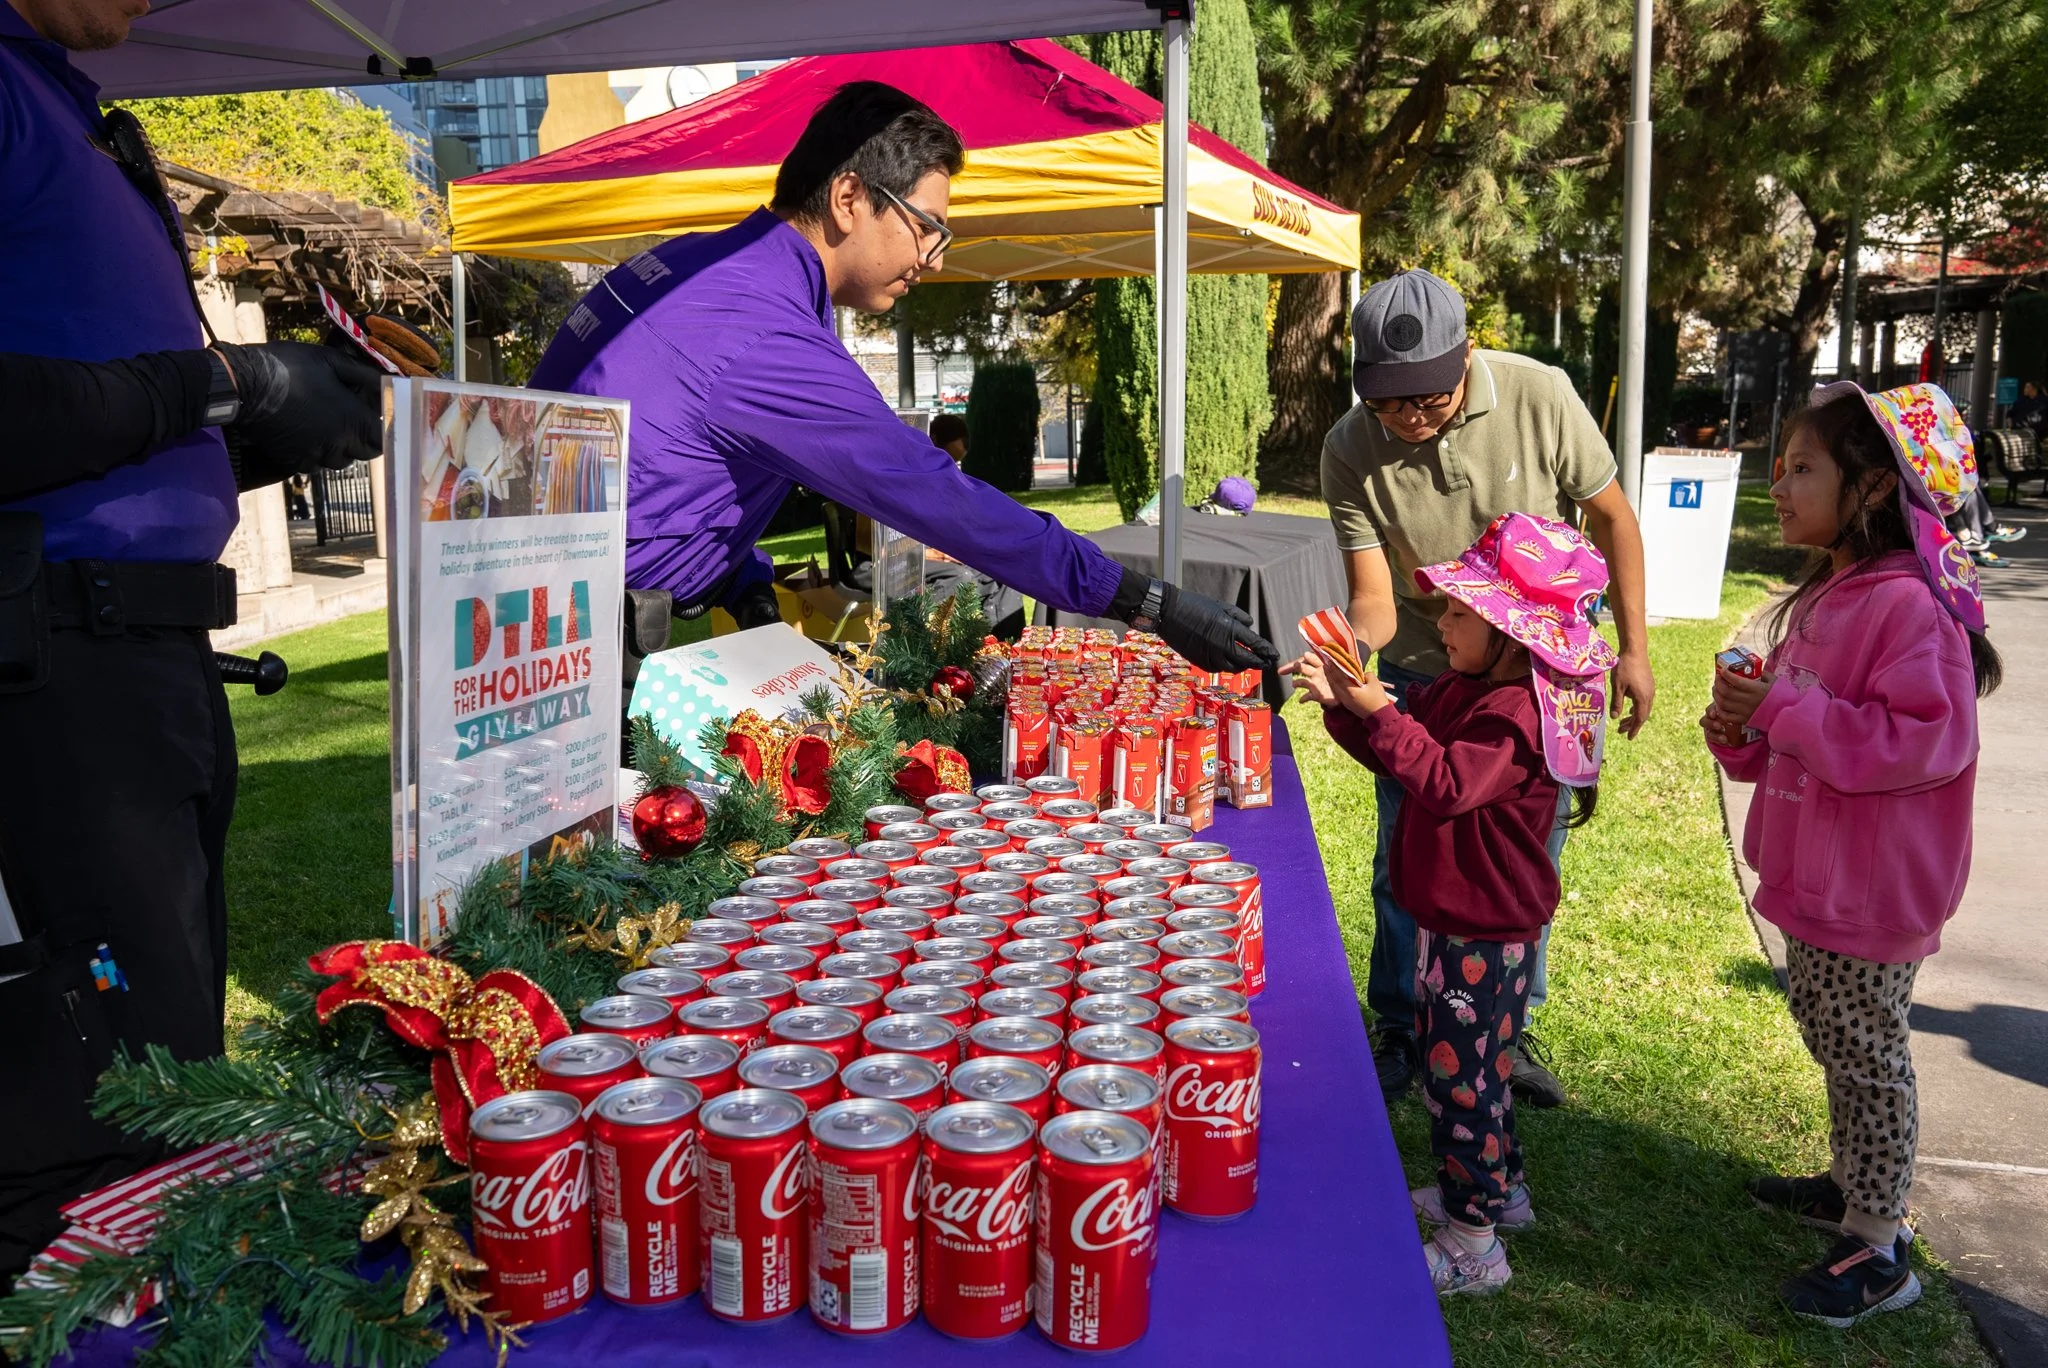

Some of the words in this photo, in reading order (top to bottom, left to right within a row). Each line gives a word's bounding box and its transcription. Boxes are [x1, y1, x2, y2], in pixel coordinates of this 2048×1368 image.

[1252, 181, 1278, 223] SUN
[1276, 195, 1312, 237] DEVILS
[626, 251, 673, 286] STRICT
[441, 542, 466, 556] Three
[467, 540, 488, 555] lucky
[488, 538, 519, 552] winners
[520, 536, 533, 547] will
[533, 535, 543, 546] be
[543, 533, 570, 545] treated
[570, 533, 578, 543] to
[584, 530, 610, 544] magical
[439, 562, 472, 577] holiday
[472, 556, 512, 573] adventure
[512, 554, 521, 567] in
[521, 554, 534, 566] the
[534, 551, 553, 565] heart
[553, 550, 563, 566] of
[563, 547, 599, 561] Downtown
[599, 545, 610, 558] LA!
[455, 580, 592, 671] DTLA
[454, 676, 477, 698] FOR
[479, 646, 592, 709] HOLIDAYS
[751, 661, 827, 699] SusieCakes
[454, 695, 477, 717] THE
[466, 692, 585, 751] GIVEAWAY
[565, 741, 581, 755] $200
[570, 756, 586, 769] Baar
[586, 752, 599, 764] Baar
[564, 773, 581, 788] $100
[501, 819, 514, 833] The
[515, 810, 536, 828] Library
[536, 802, 554, 816] Store
[1442, 989, 1456, 1000] OLD
[1457, 989, 1475, 1003] NAVY
[1165, 1063, 1261, 1129] Coca-C
[1205, 1127, 1252, 1139] ORIGINAL
[471, 1140, 589, 1229] ca-Col
[1168, 1176, 1178, 1202] ME
[533, 1219, 572, 1239] TASTE
[935, 1235, 992, 1253] ORIGINAL
[997, 1232, 1029, 1251] TASTE
[647, 1220, 664, 1298] RECYCLE
[762, 1234, 777, 1313] RECYCLE
[664, 1266, 678, 1296] ME
[903, 1235, 914, 1317] RECYCLE
[778, 1279, 790, 1310] ME
[1069, 1263, 1085, 1344] RECYCLE
[1084, 1316, 1099, 1344] ME
